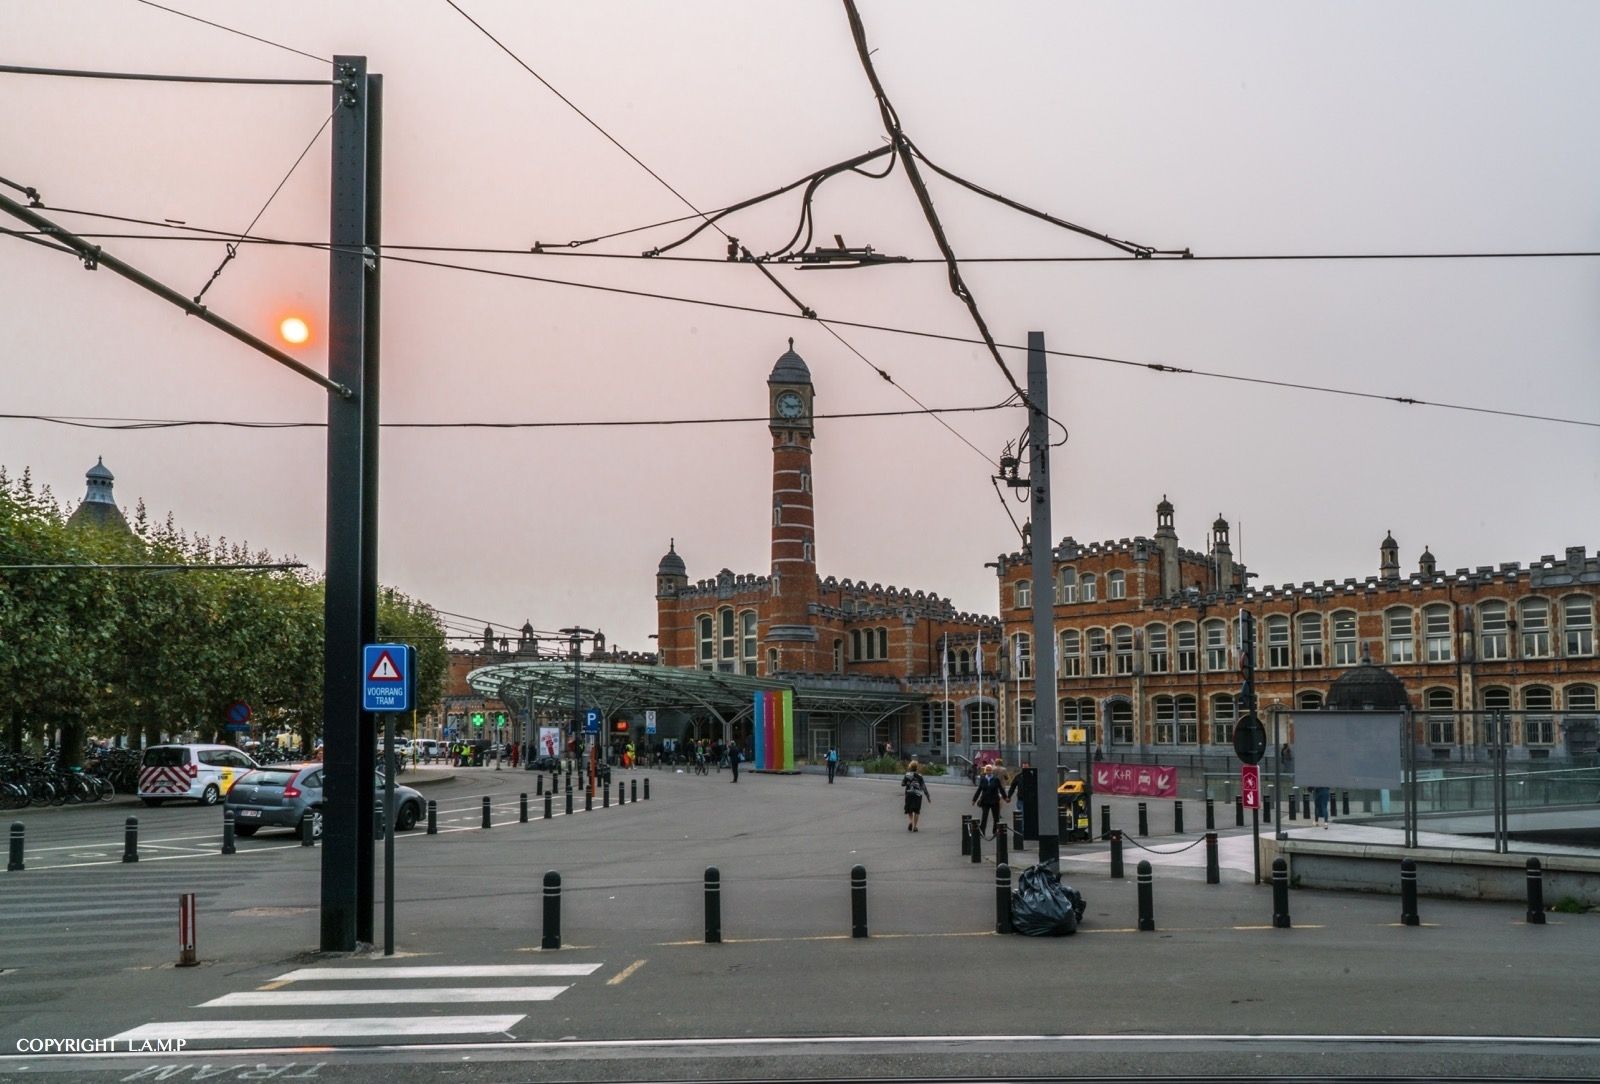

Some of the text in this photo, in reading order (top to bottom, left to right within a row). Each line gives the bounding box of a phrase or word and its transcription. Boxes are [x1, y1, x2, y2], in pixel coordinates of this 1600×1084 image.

[367, 687, 404, 696] VOORRANG
[376, 696, 395, 705] TRAM
[587, 713, 597, 726] P
[1114, 769, 1132, 780] K+R
[120, 1062, 328, 1082] TRAM
